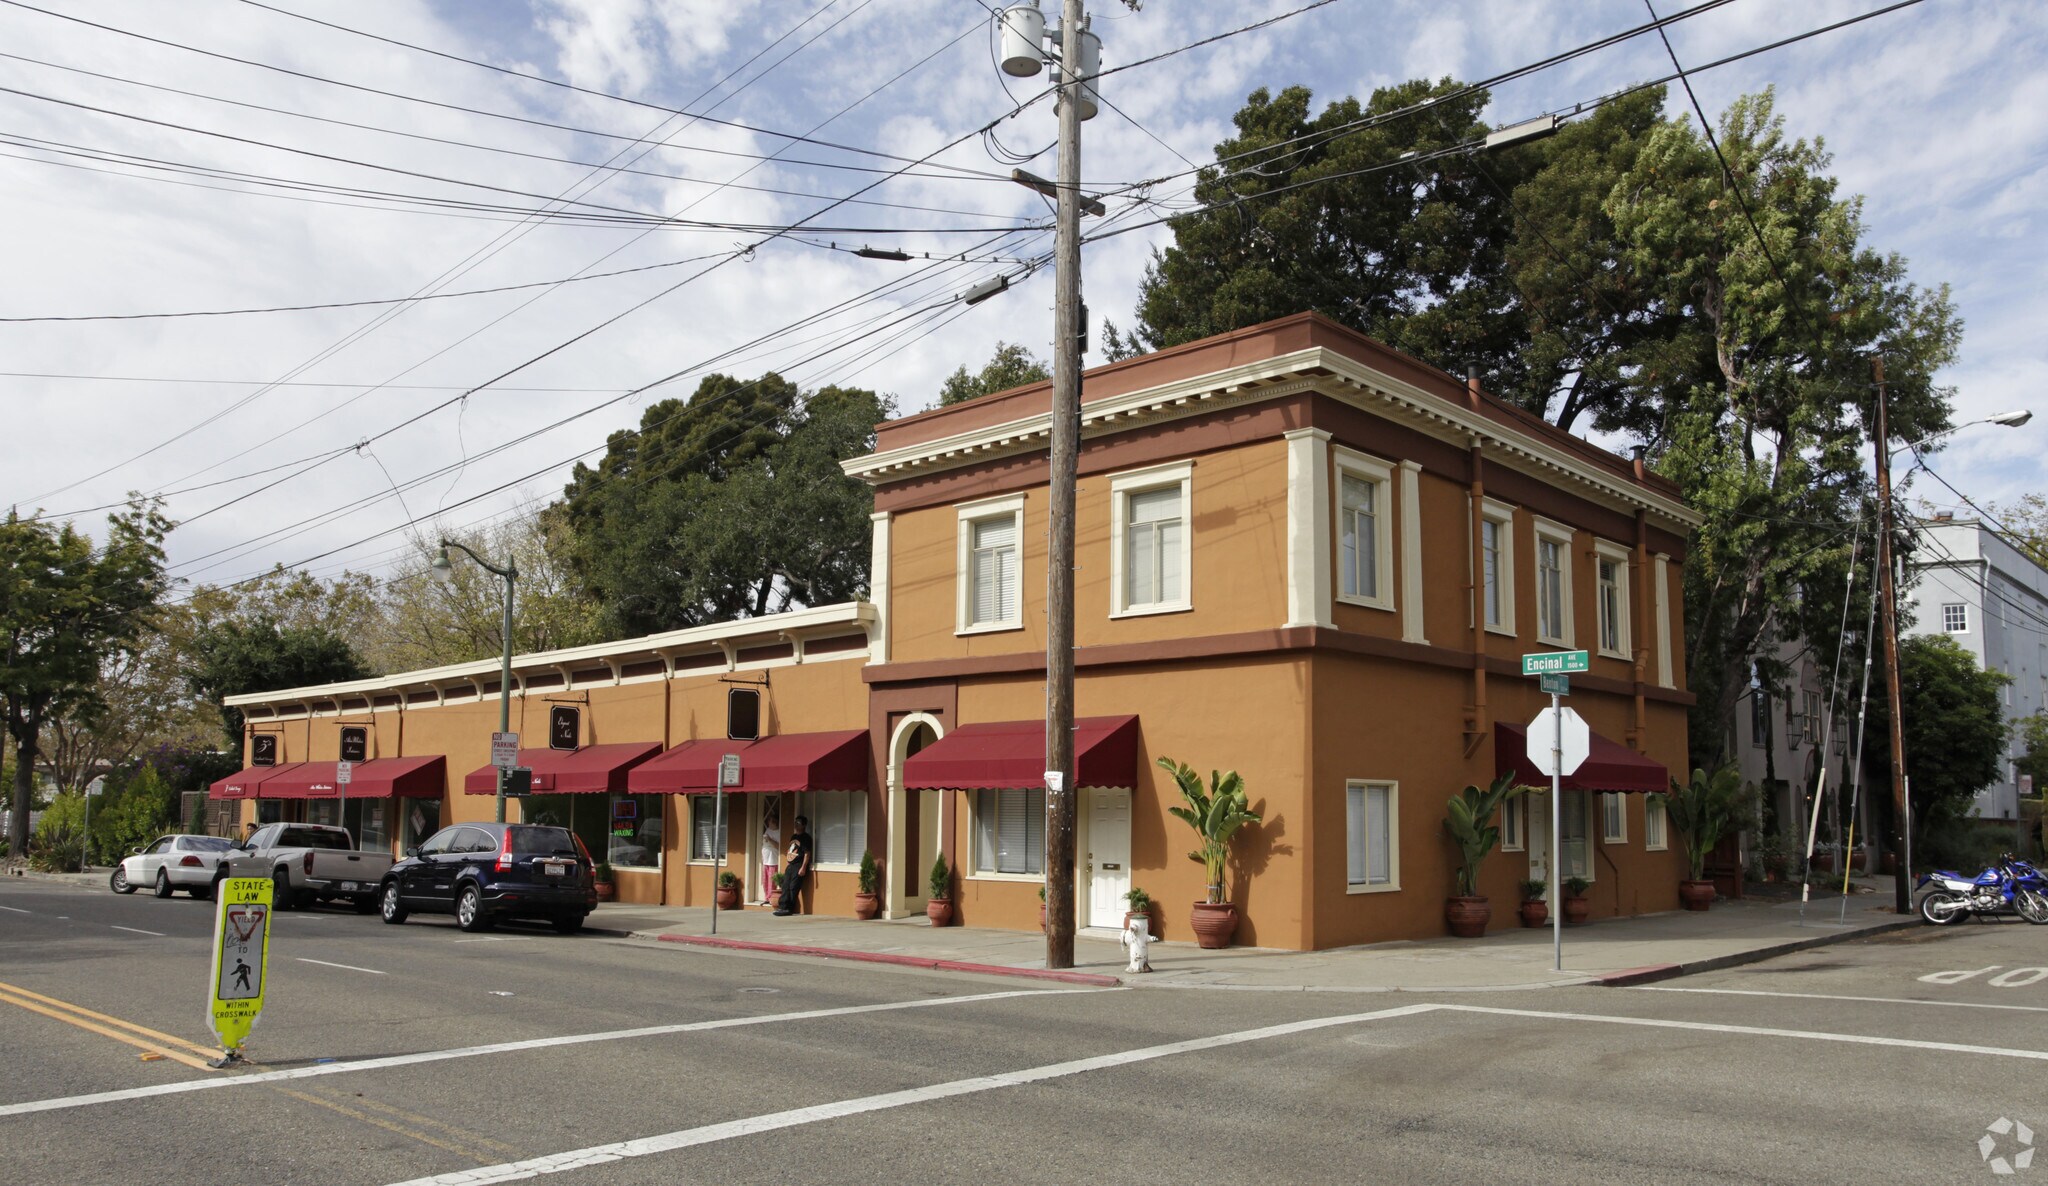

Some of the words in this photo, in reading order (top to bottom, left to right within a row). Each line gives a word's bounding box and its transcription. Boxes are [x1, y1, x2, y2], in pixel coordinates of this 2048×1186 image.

[1527, 656, 1562, 670] Encinal
[493, 741, 517, 749] PARKING
[614, 829, 634, 837] WAXING
[233, 881, 265, 891] STATE
[237, 892, 259, 902] LAW
[237, 916, 256, 924] YIELD
[238, 946, 248, 954] TO
[226, 1001, 250, 1009] WITHIN
[215, 1009, 257, 1019] CROSSWALK
